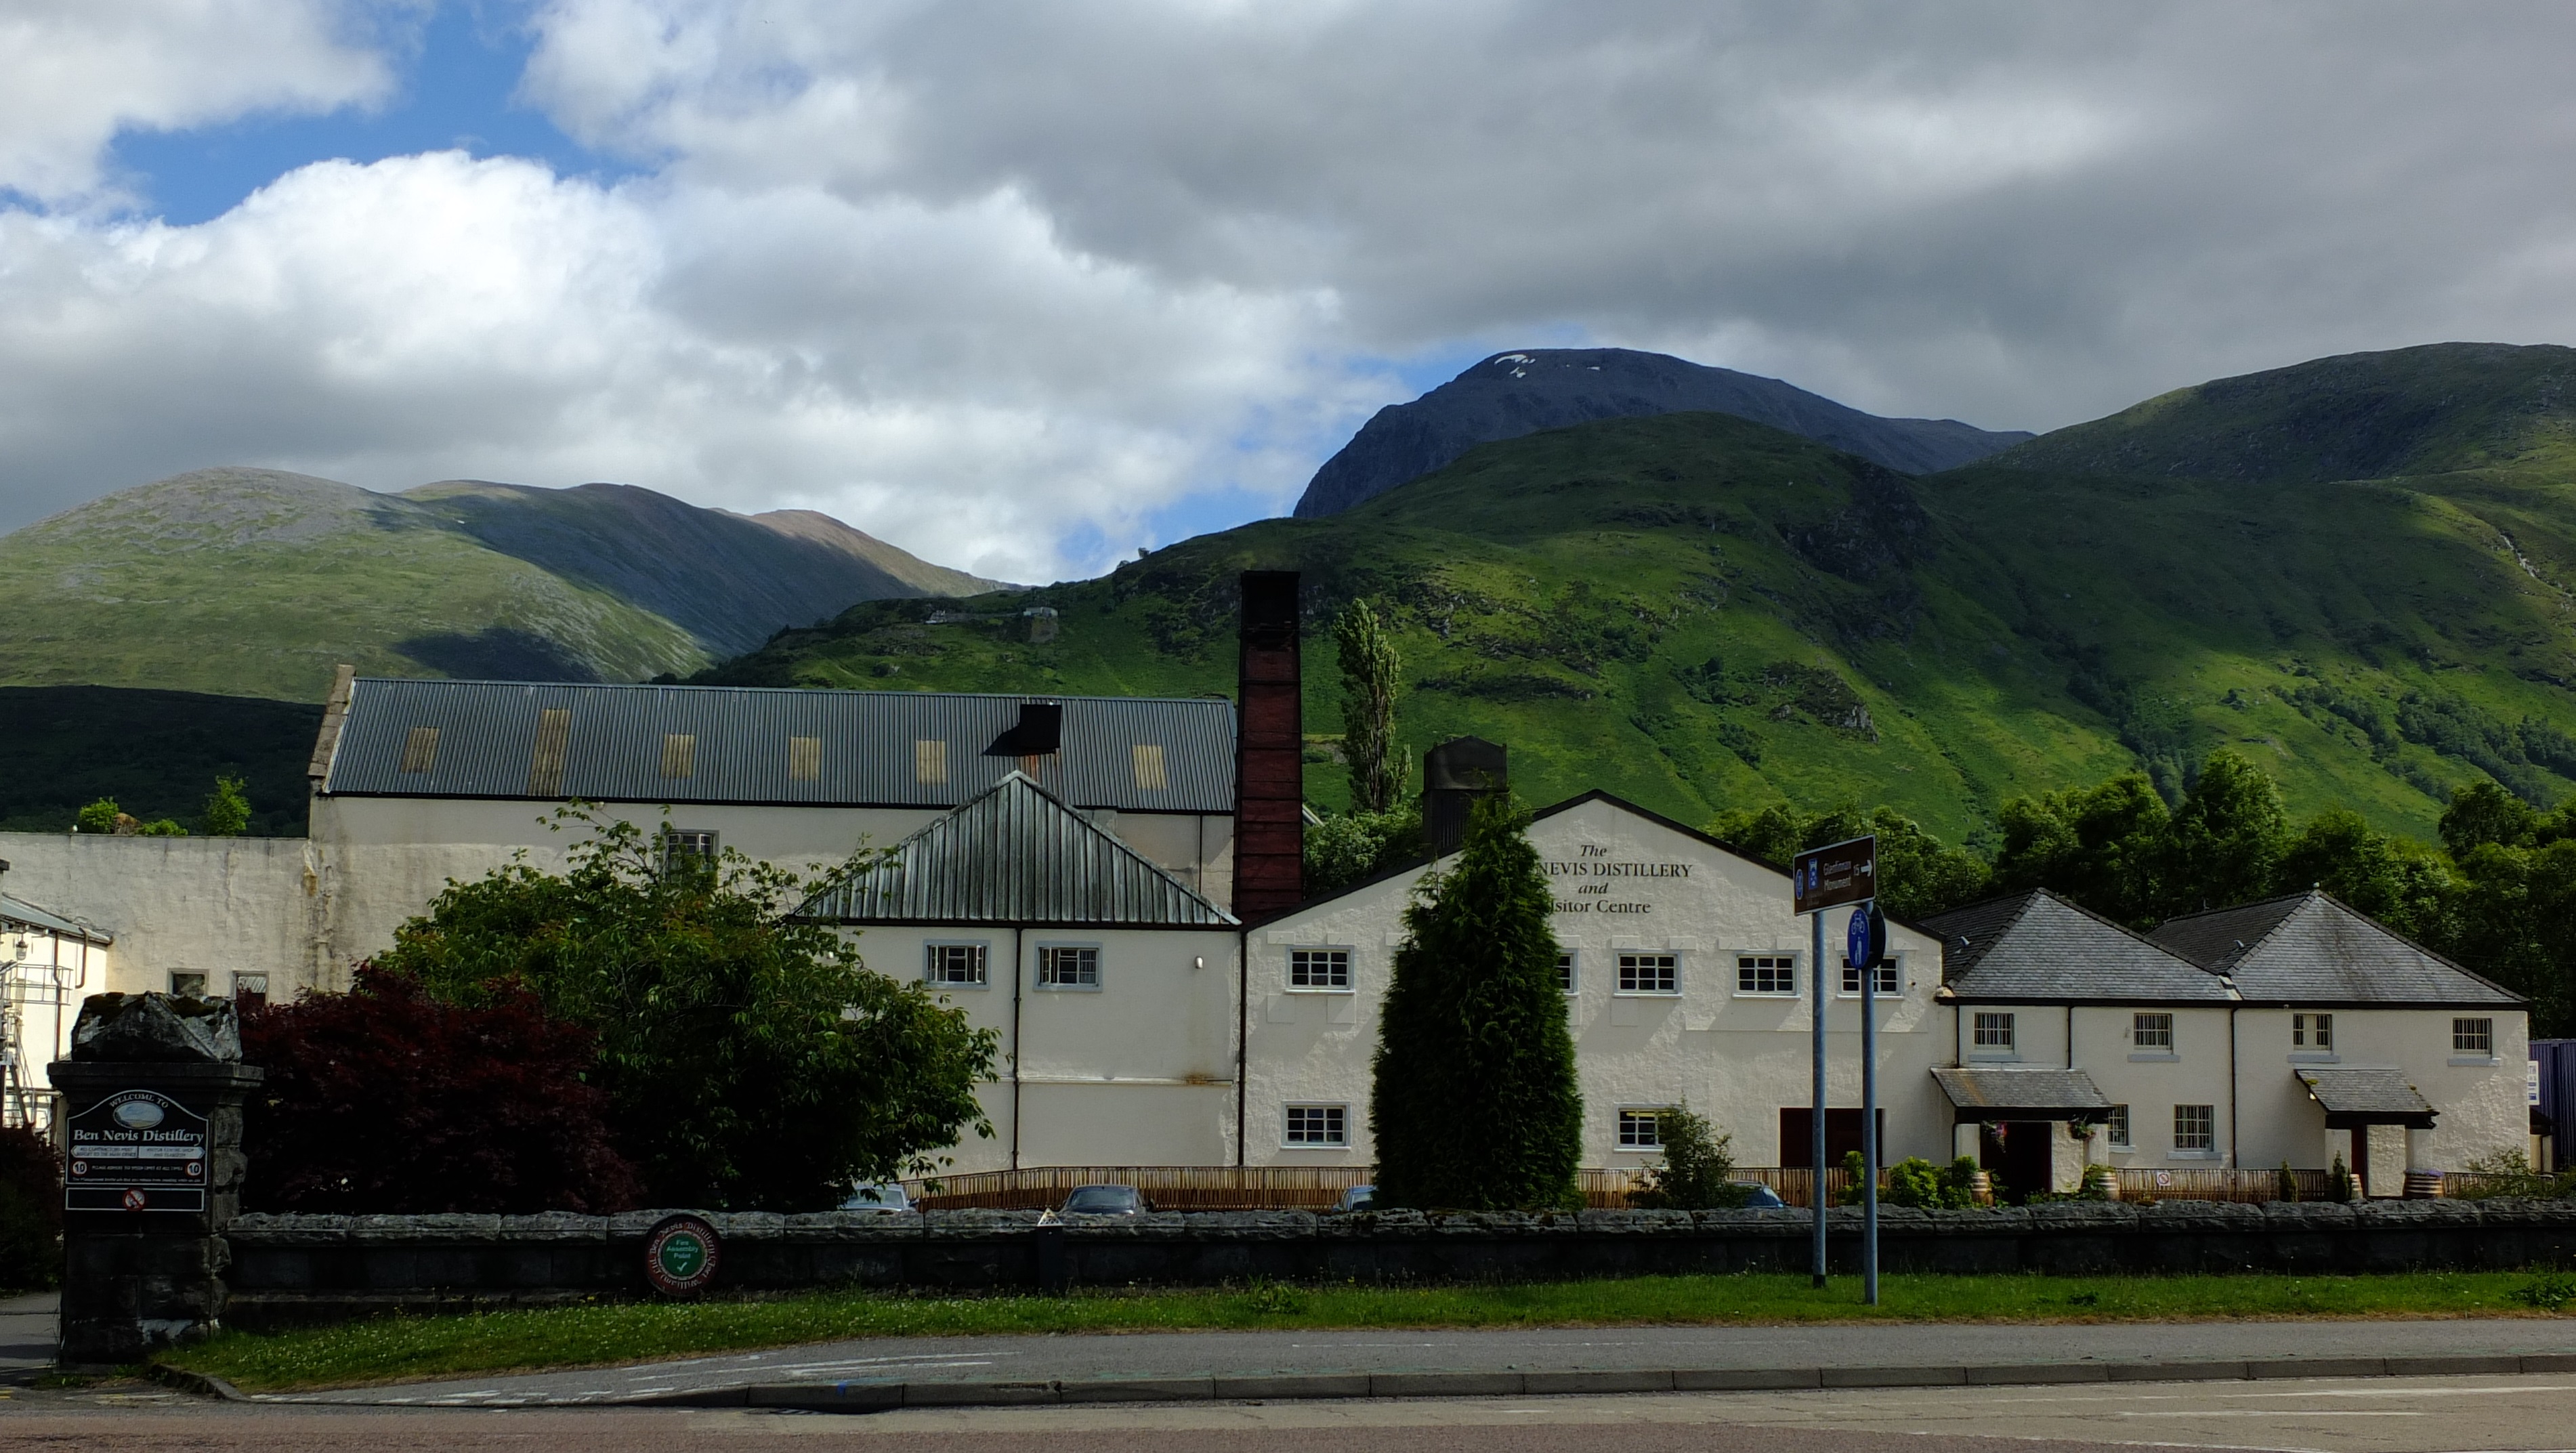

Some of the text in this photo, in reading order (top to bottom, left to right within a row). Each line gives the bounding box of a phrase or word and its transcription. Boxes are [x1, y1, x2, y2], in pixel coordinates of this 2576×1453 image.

[1580, 845, 1607, 858] The
[1536, 861, 1693, 878] NEVIS DISTILLERY
[1578, 882, 1609, 894] and
[1548, 899, 1651, 914] isitor Centre
[109, 1093, 169, 1108] WELCOME TO
[73, 1129, 205, 1147] Ben Nevis Distillery
[75, 1164, 85, 1173] 10
[189, 1164, 199, 1173] 10
[650, 1239, 660, 1254] Ben
